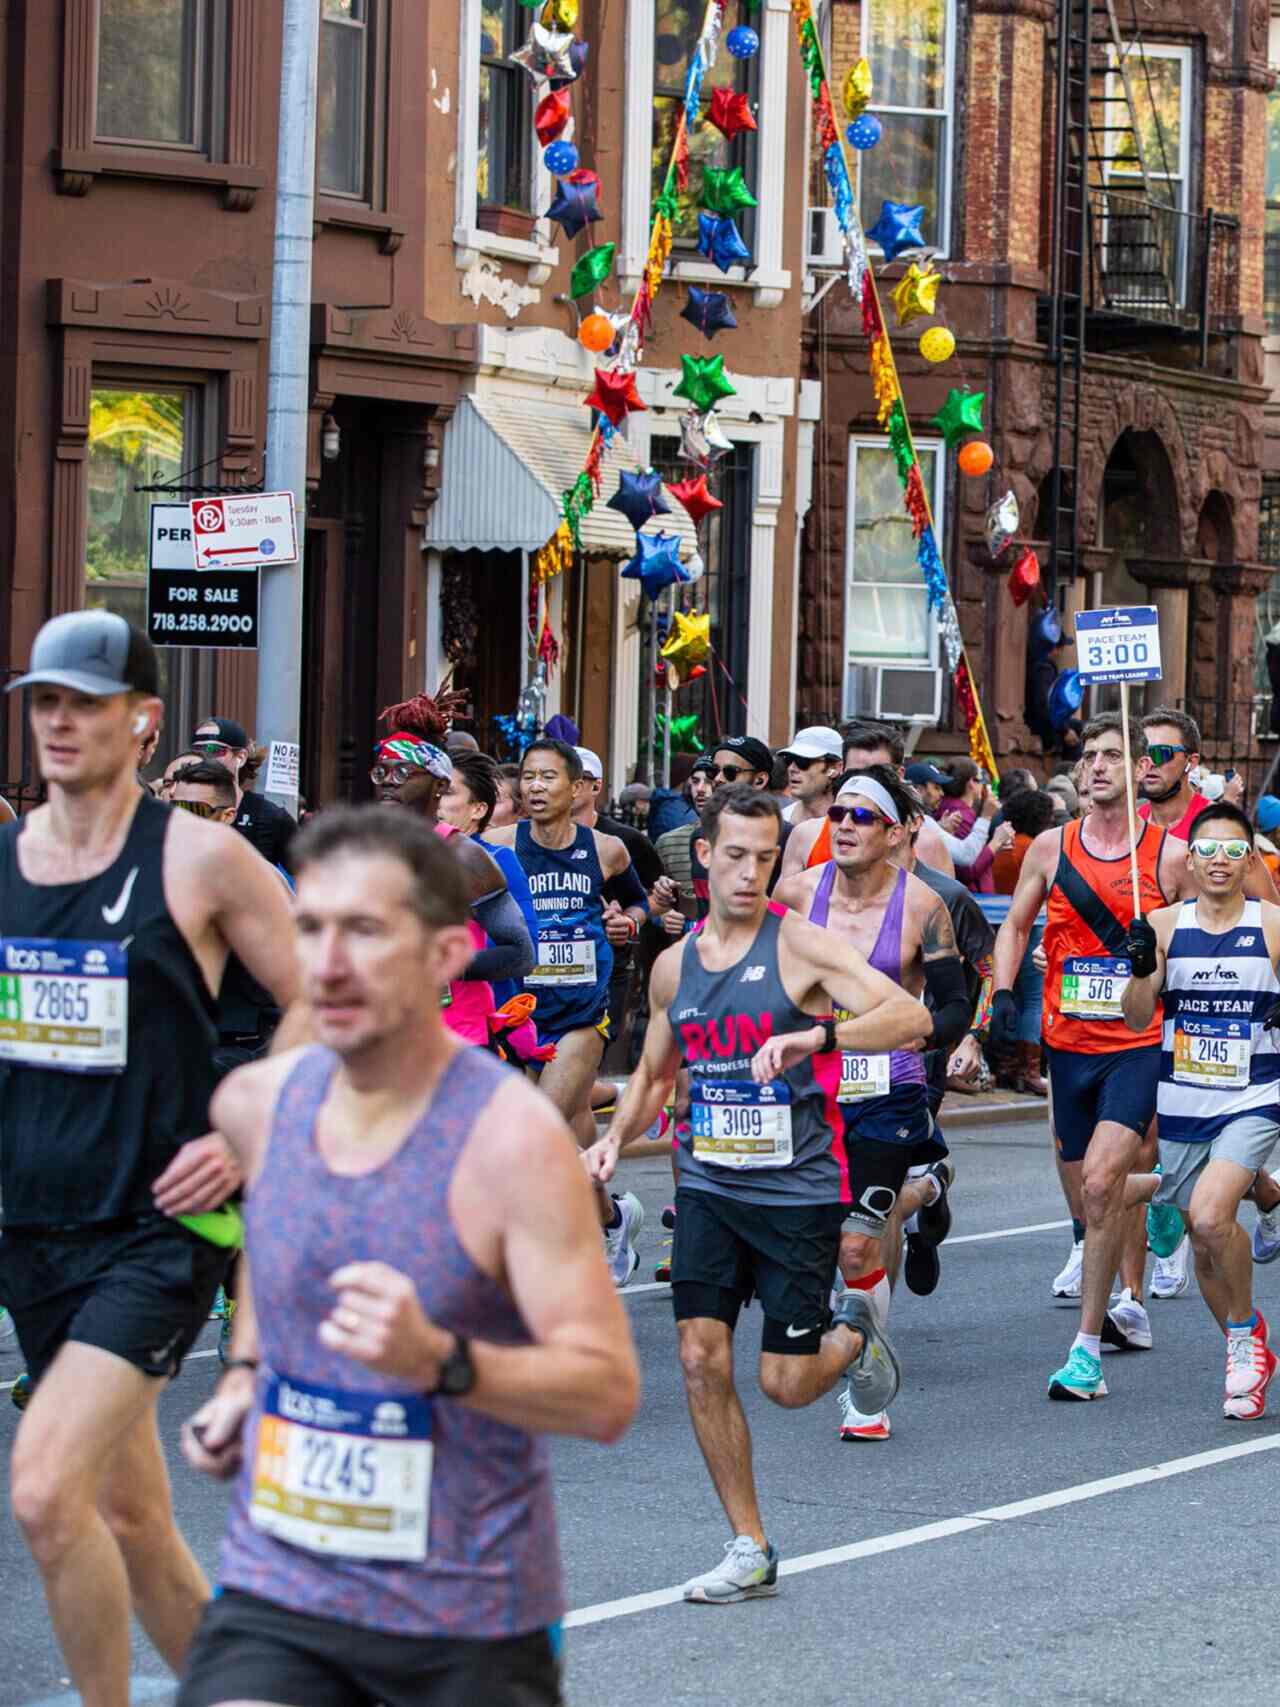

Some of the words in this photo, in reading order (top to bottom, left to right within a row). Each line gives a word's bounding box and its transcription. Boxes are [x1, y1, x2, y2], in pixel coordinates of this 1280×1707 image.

[228, 506, 258, 515] Tuesday
[157, 528, 191, 541] PER
[168, 588, 198, 602] FOR
[204, 588, 239, 603] SALE
[152, 612, 253, 632] 718.258.2900
[1088, 635, 1116, 645] PACE
[1119, 633, 1147, 642] TEAM
[1088, 643, 1149, 666] 3:00
[273, 744, 288, 757] NO
[528, 872, 591, 895] ORTLAND
[549, 943, 574, 964] 3113
[1073, 960, 1090, 972] tcs
[1088, 979, 1113, 1000] 576
[34, 979, 89, 1021] 2865
[1212, 1000, 1255, 1014] TEAM
[680, 1011, 772, 1062] RUN
[1183, 1020, 1201, 1034] tcs
[1198, 1038, 1229, 1063] 2145
[842, 1058, 869, 1081] 083
[703, 1083, 725, 1102] tcs
[723, 1108, 762, 1136] 3109
[302, 1433, 377, 1497] 2245
